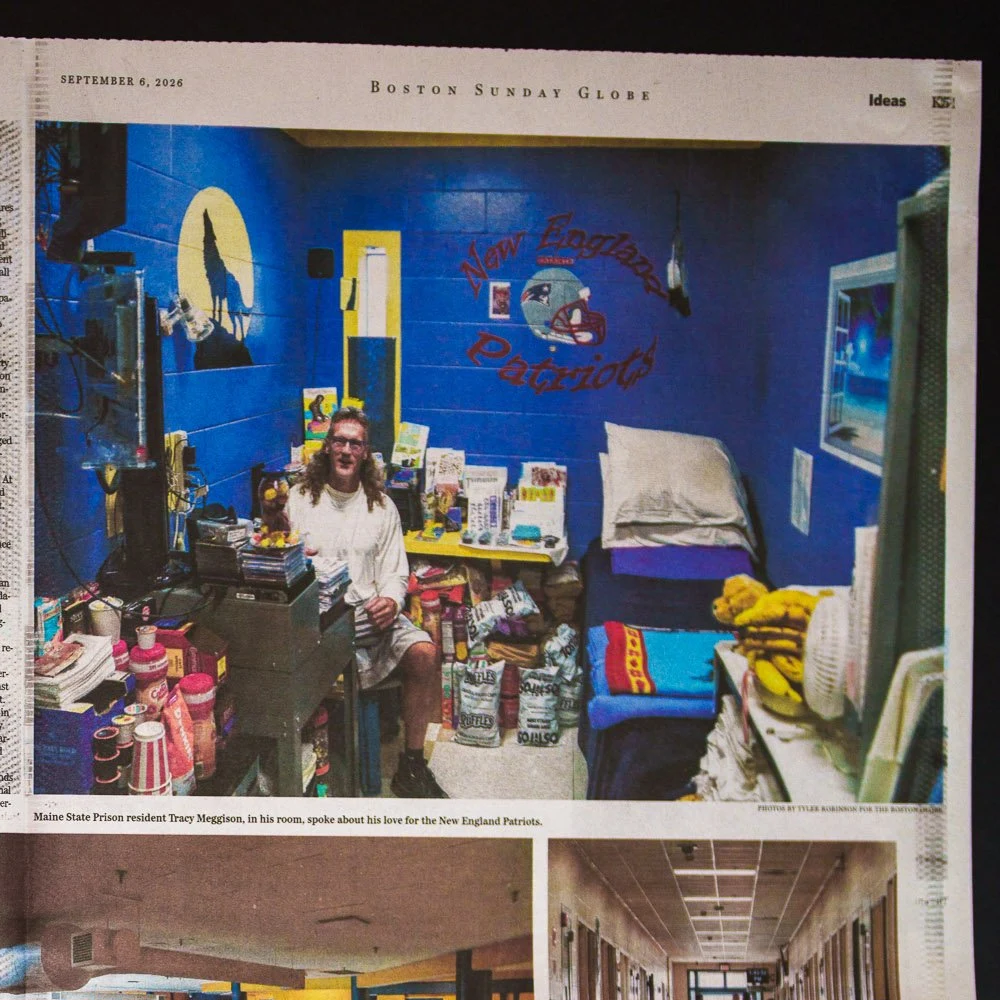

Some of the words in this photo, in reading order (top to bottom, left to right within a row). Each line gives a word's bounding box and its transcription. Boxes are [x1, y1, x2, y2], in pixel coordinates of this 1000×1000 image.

[60, 74, 134, 86] SEPTEMBER
[139, 77, 149, 87] 6,
[154, 78, 183, 87] 2026
[868, 93, 906, 107] Ideas
[460, 231, 528, 299] New
[536, 212, 671, 299] England
[466, 331, 658, 395] Patriots
[33, 812, 64, 821] Maine
[65, 812, 90, 821] State
[92, 812, 124, 822] Prison
[126, 812, 166, 822] resident
[168, 813, 194, 824] Tracy
[196, 813, 245, 825] Meggison,
[247, 814, 257, 823] in
[259, 814, 274, 823] his
[276, 816, 304, 824] room,
[307, 814, 335, 826] spoke
[336, 814, 364, 824] about
[366, 815, 381, 824] his
[383, 815, 402, 824] love
[404, 815, 419, 824] for
[421, 815, 436, 824] the
[438, 816, 459, 825] New
[461, 816, 500, 827] England
[503, 816, 542, 826] Patriots.
